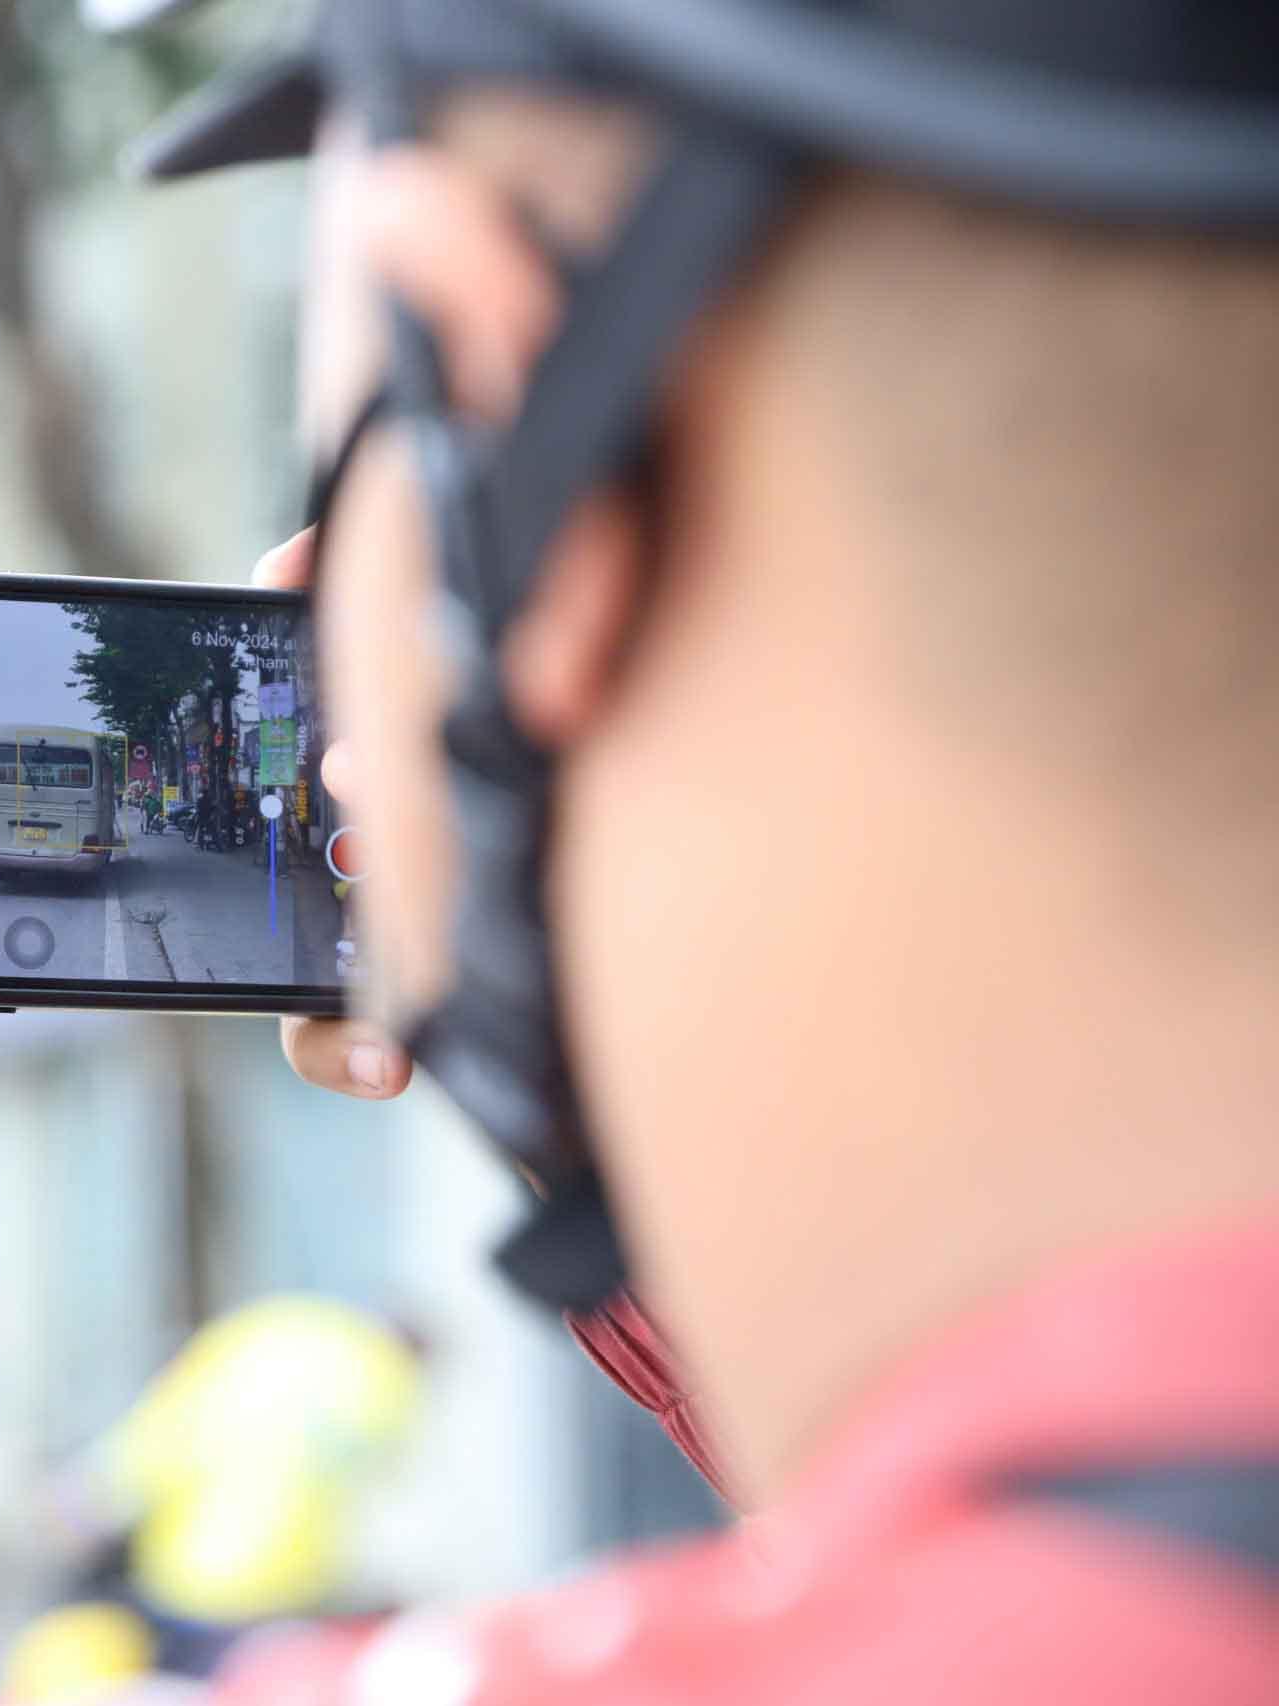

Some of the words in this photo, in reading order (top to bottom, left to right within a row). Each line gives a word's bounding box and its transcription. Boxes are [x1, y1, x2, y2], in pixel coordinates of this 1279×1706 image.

[191, 631, 201, 646] 6
[206, 631, 236, 648] Nov
[241, 633, 279, 649] 2024
[296, 725, 307, 766] Photo
[295, 779, 308, 818] Video
